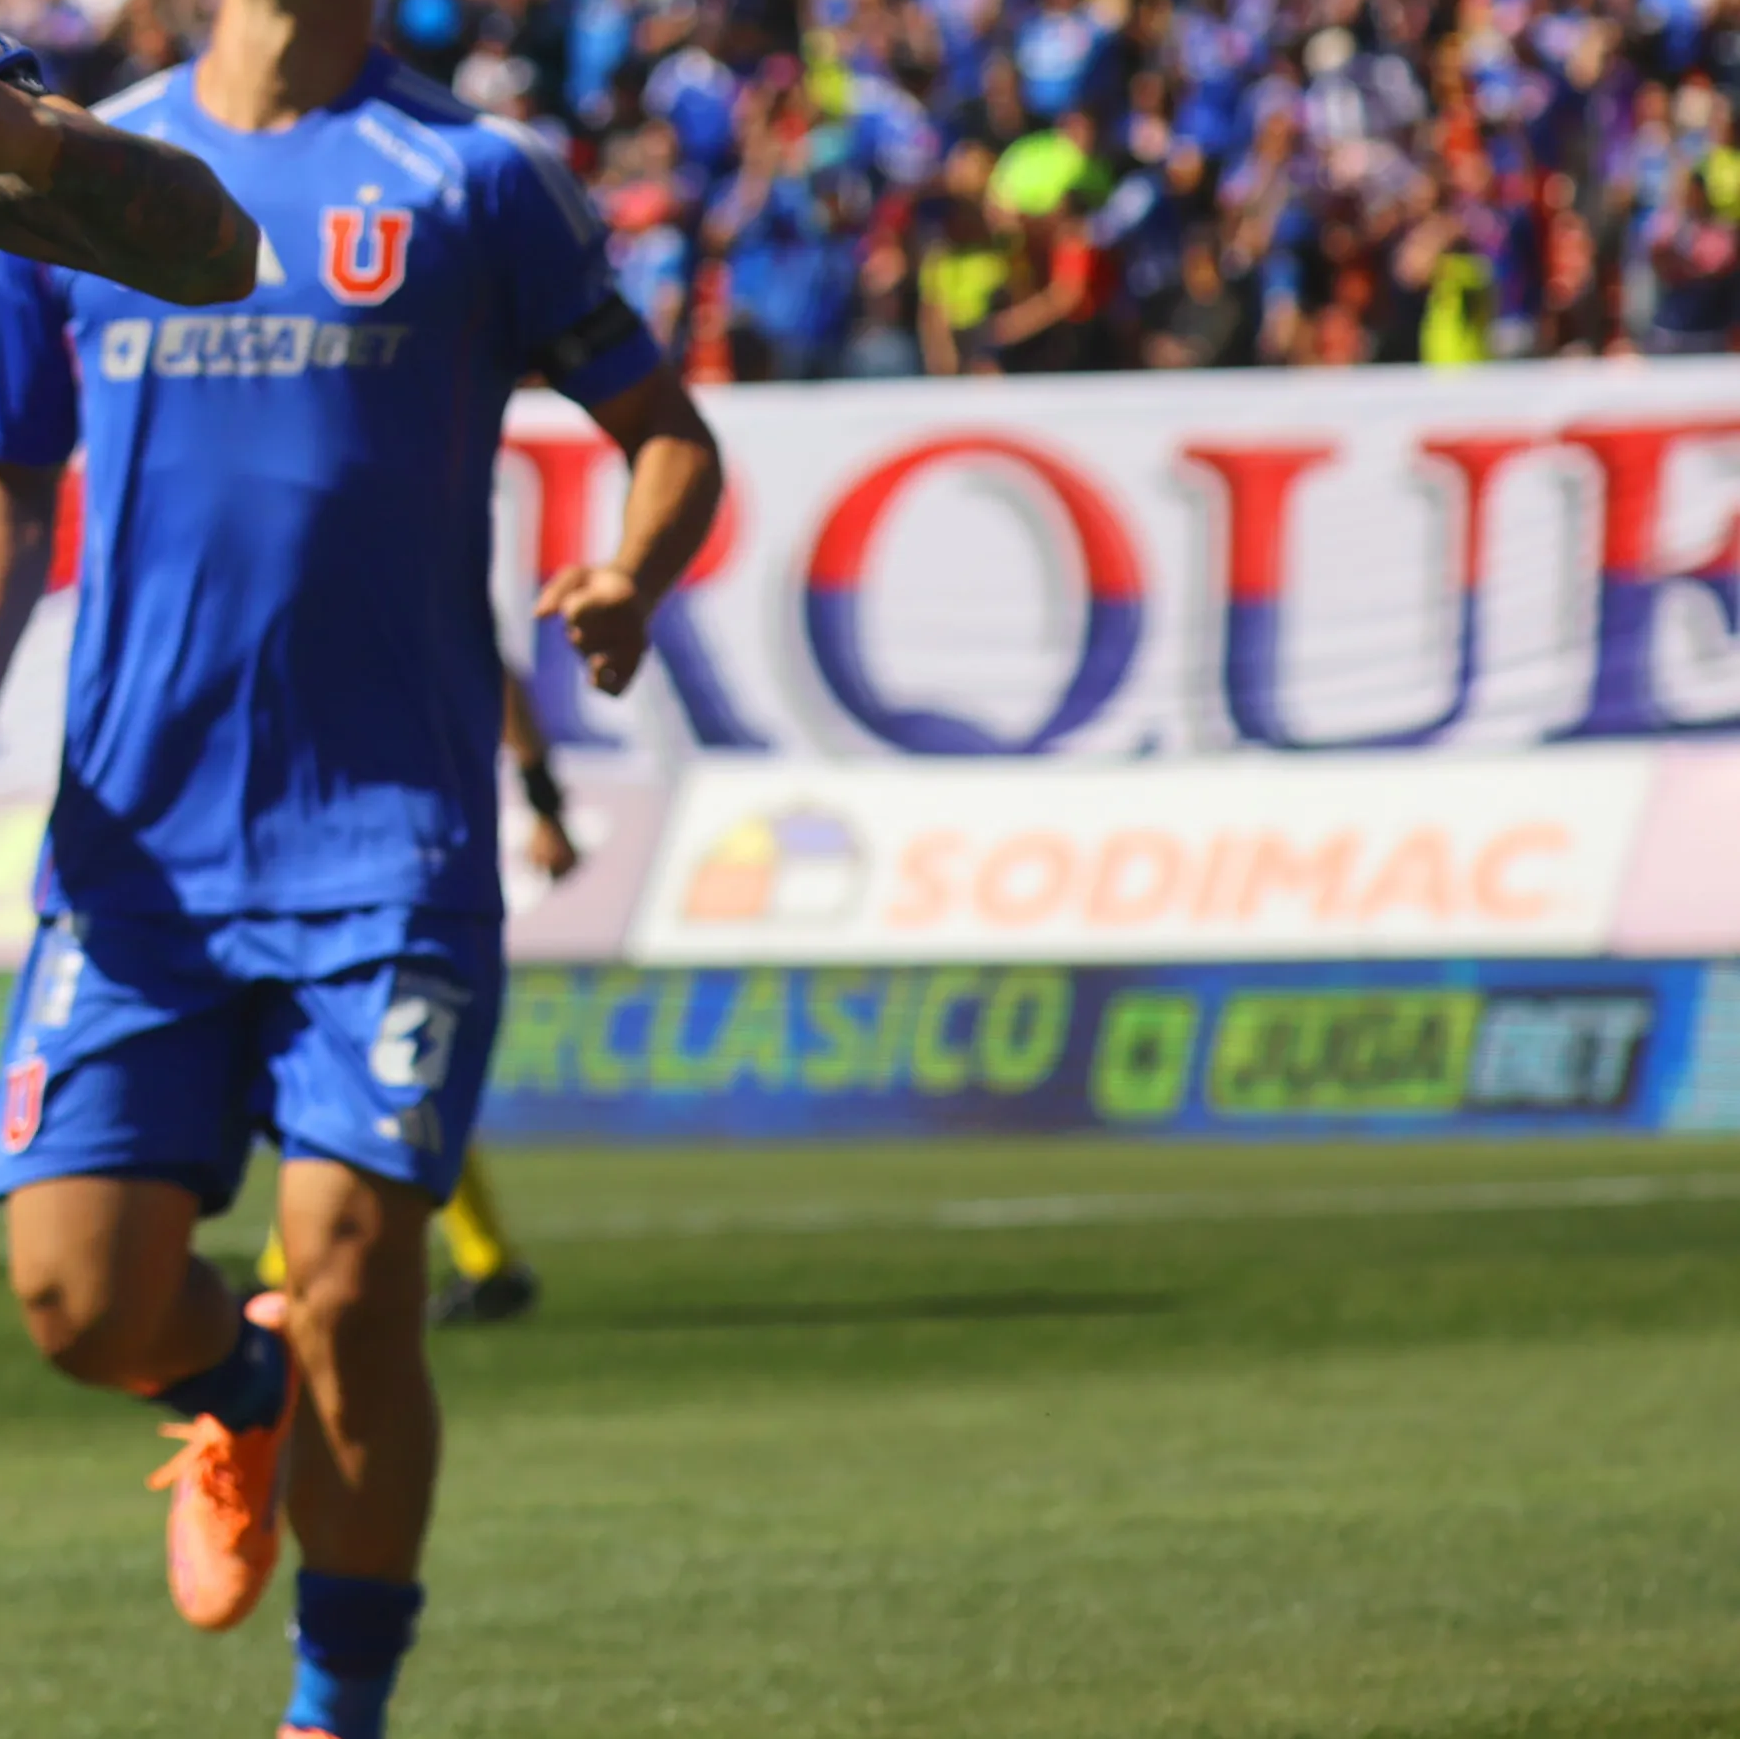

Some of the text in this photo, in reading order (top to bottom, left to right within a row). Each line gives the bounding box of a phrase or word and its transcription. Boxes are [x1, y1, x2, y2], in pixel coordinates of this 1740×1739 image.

[320, 208, 414, 305] U
[887, 823, 1573, 926] SODIMAC
[499, 964, 1073, 1096] RCLASICO
